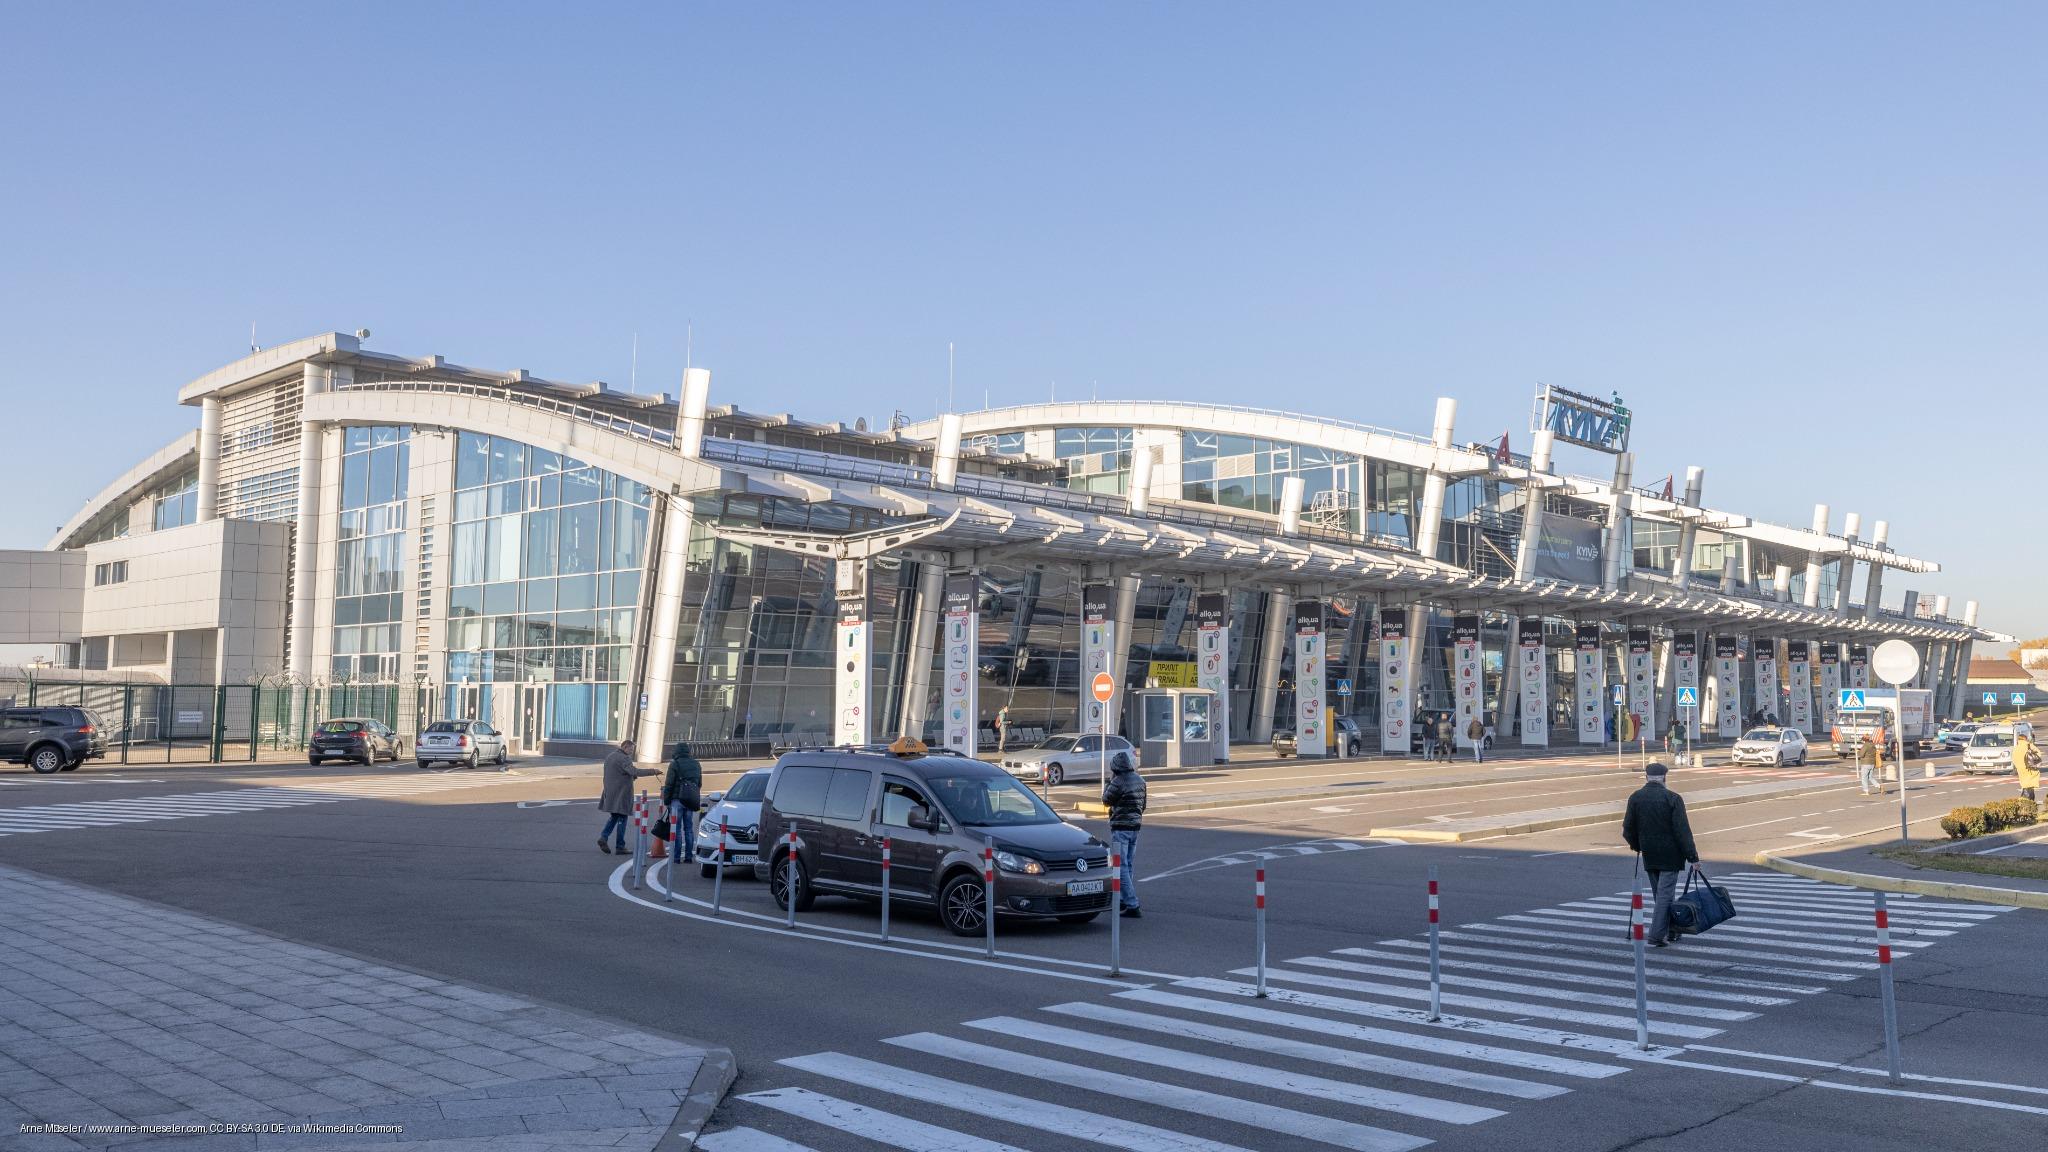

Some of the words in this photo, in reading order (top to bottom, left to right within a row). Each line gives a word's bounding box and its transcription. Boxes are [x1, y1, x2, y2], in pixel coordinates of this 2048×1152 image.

[1552, 399, 1608, 444] KYIV
[840, 603, 862, 614] allo.ua
[1199, 610, 1221, 619] allo.ua
[1297, 616, 1319, 625] allo.ua
[1382, 622, 1403, 631] allo.ua
